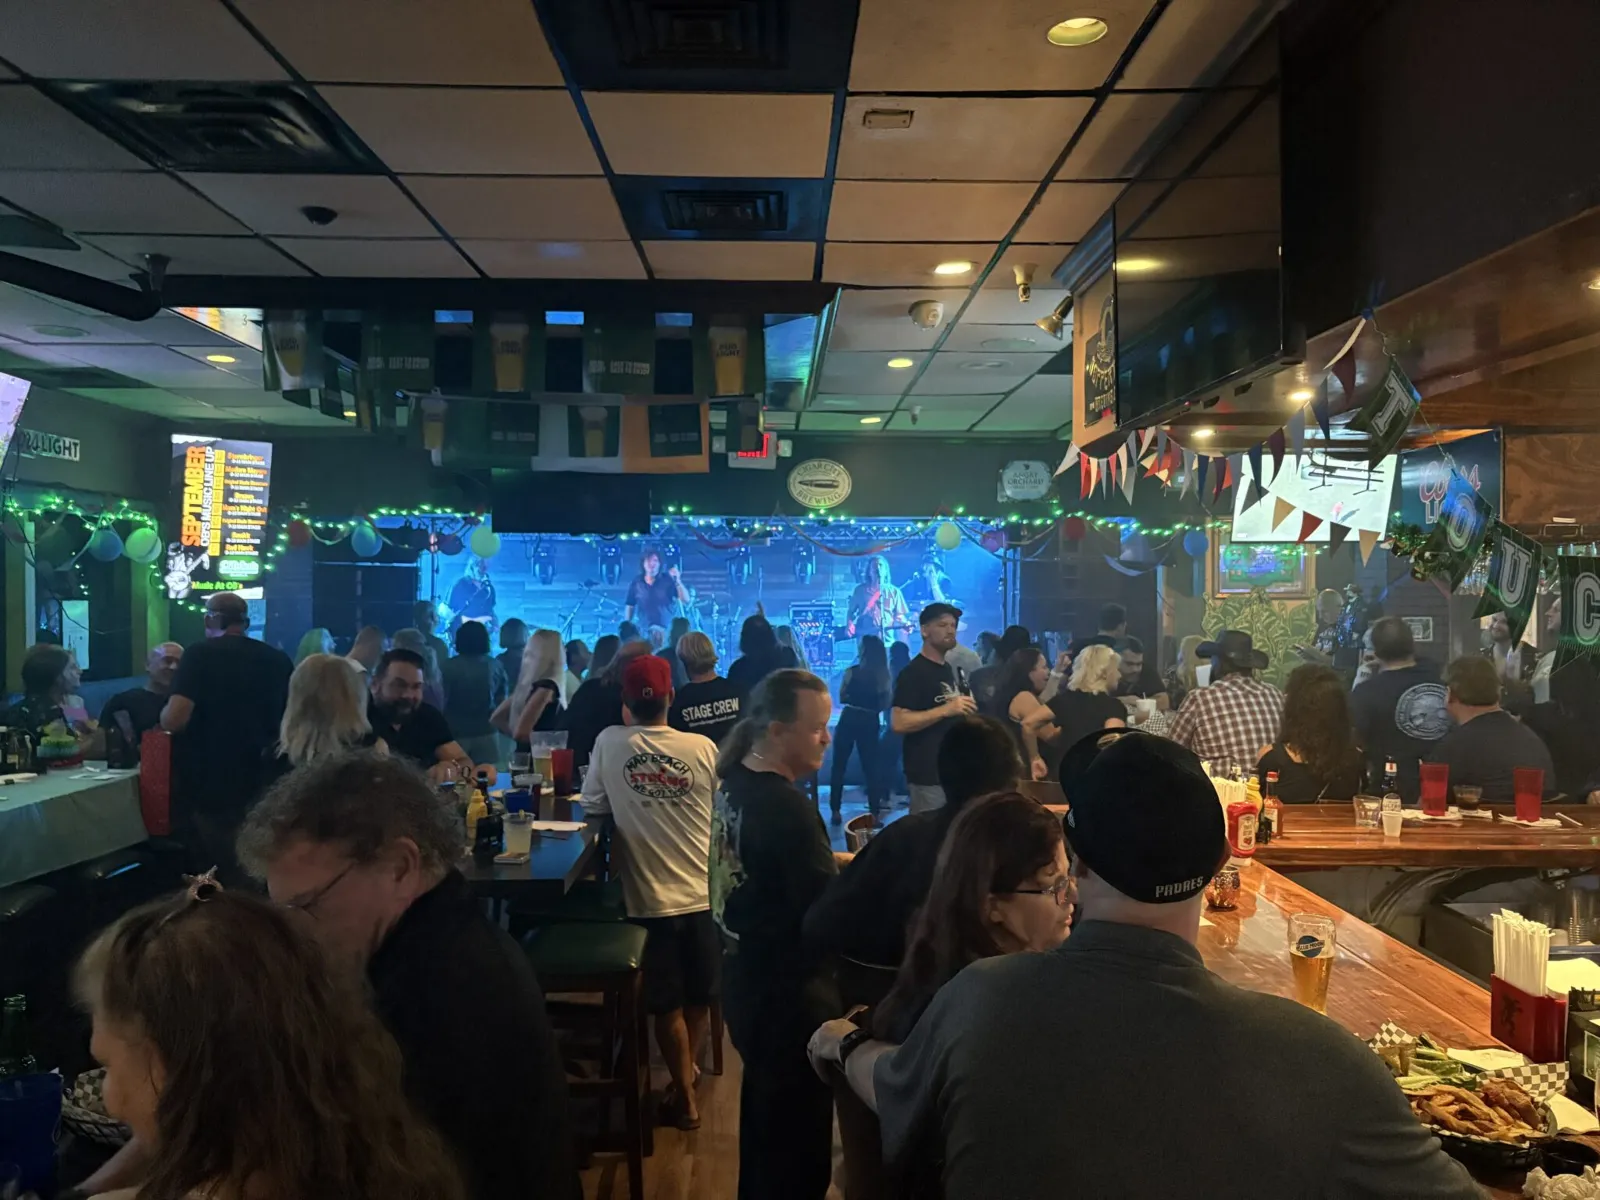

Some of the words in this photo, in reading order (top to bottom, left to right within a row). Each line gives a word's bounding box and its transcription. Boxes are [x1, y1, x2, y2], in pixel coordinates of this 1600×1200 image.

[205, 446, 215, 462] UP
[797, 461, 822, 476] CIGAR
[181, 446, 206, 547] SEPTEMBER
[201, 486, 213, 521] MUSIC
[796, 489, 842, 505] BREWING
[682, 703, 713, 721] STAGE
[713, 697, 740, 716] CREW
[626, 754, 648, 773] MAD
[651, 754, 690, 775] BEACH
[1155, 876, 1204, 898] PADRES
